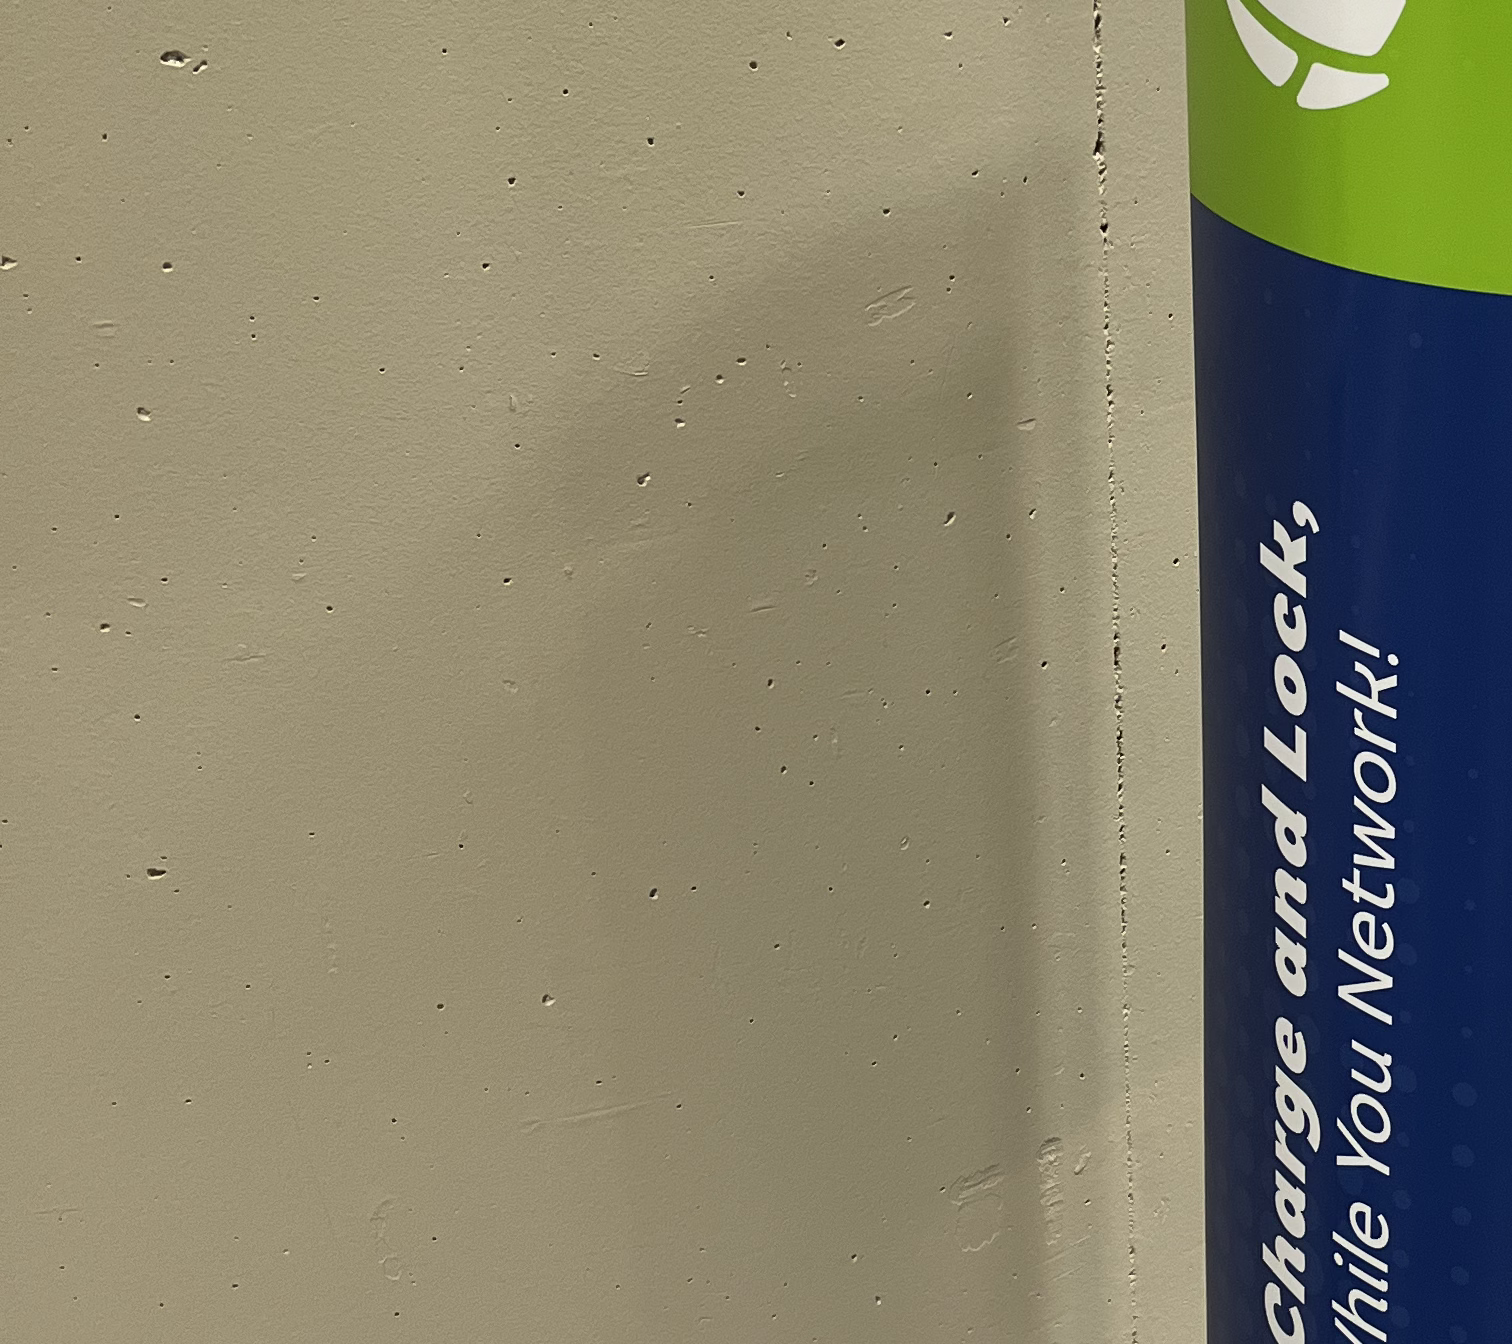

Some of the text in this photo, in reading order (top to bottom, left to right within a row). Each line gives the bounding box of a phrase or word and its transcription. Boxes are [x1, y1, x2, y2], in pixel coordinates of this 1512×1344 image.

[1260, 501, 1320, 782] Lock,
[1261, 784, 1307, 998] and
[1336, 629, 1399, 1025] Network!
[1336, 1039, 1393, 1176] You
